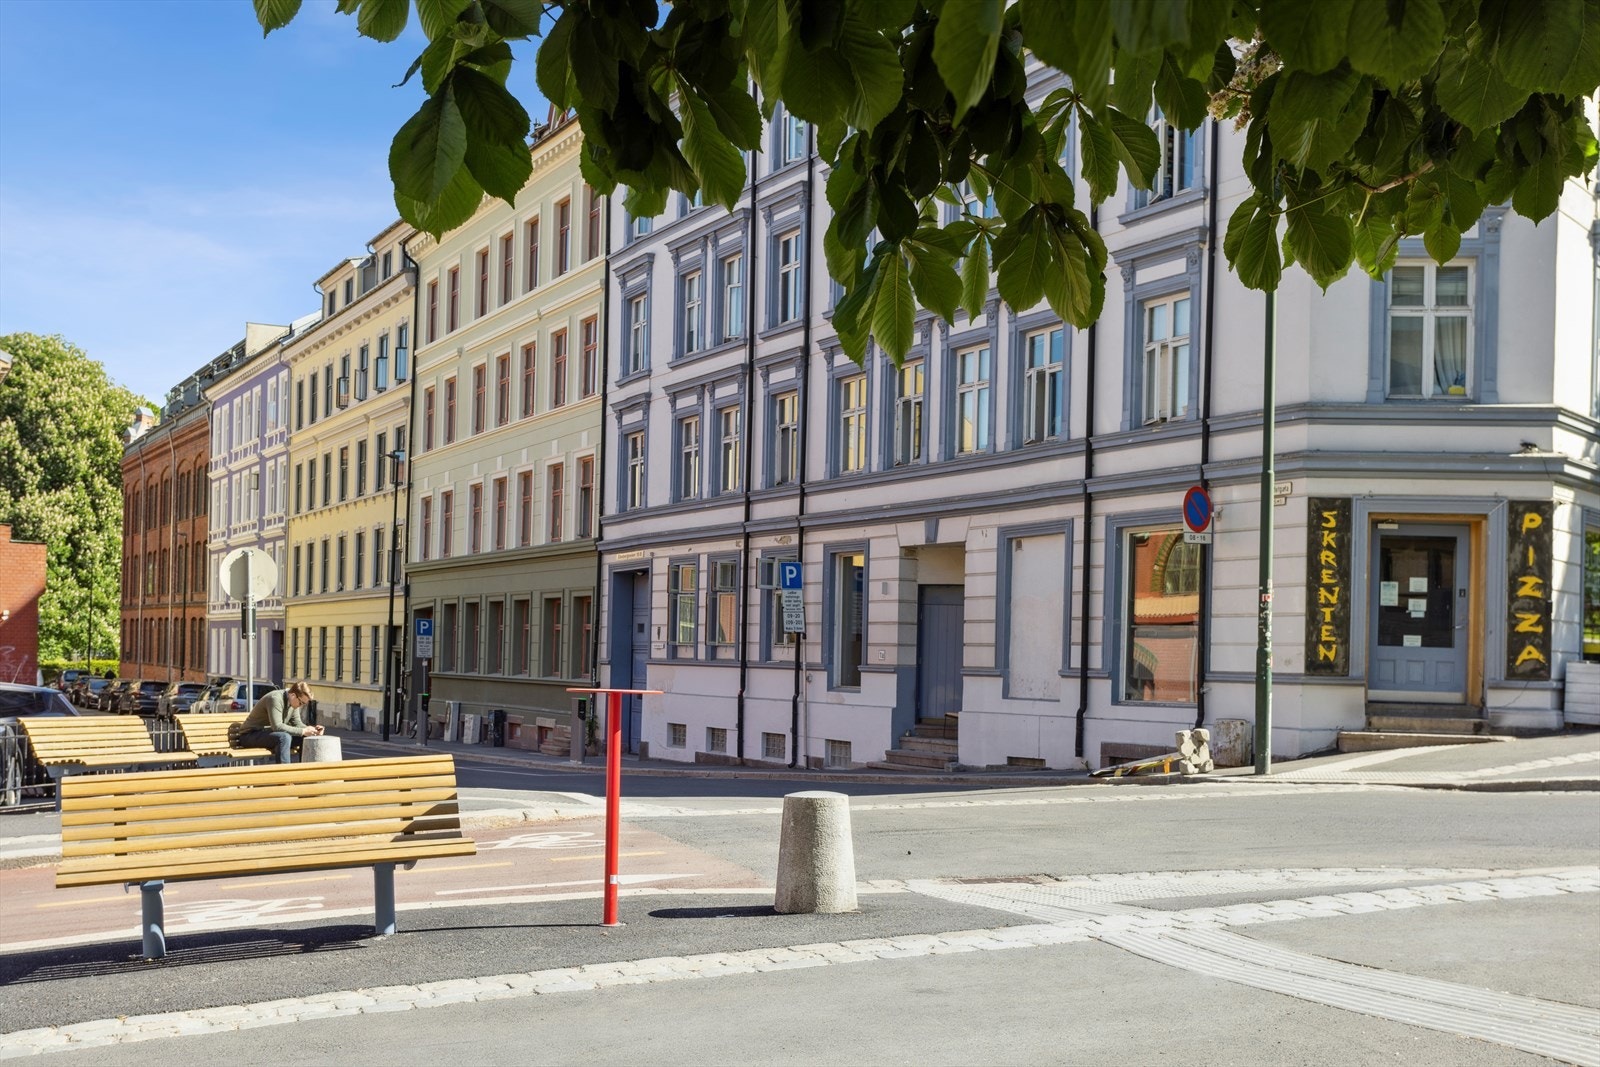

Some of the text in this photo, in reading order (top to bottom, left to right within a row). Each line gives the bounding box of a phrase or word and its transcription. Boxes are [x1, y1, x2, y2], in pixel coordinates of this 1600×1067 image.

[785, 565, 797, 586] P
[1318, 510, 1339, 662] SKRENTEN
[1515, 512, 1546, 666] PIZZA
[420, 621, 430, 634] P
